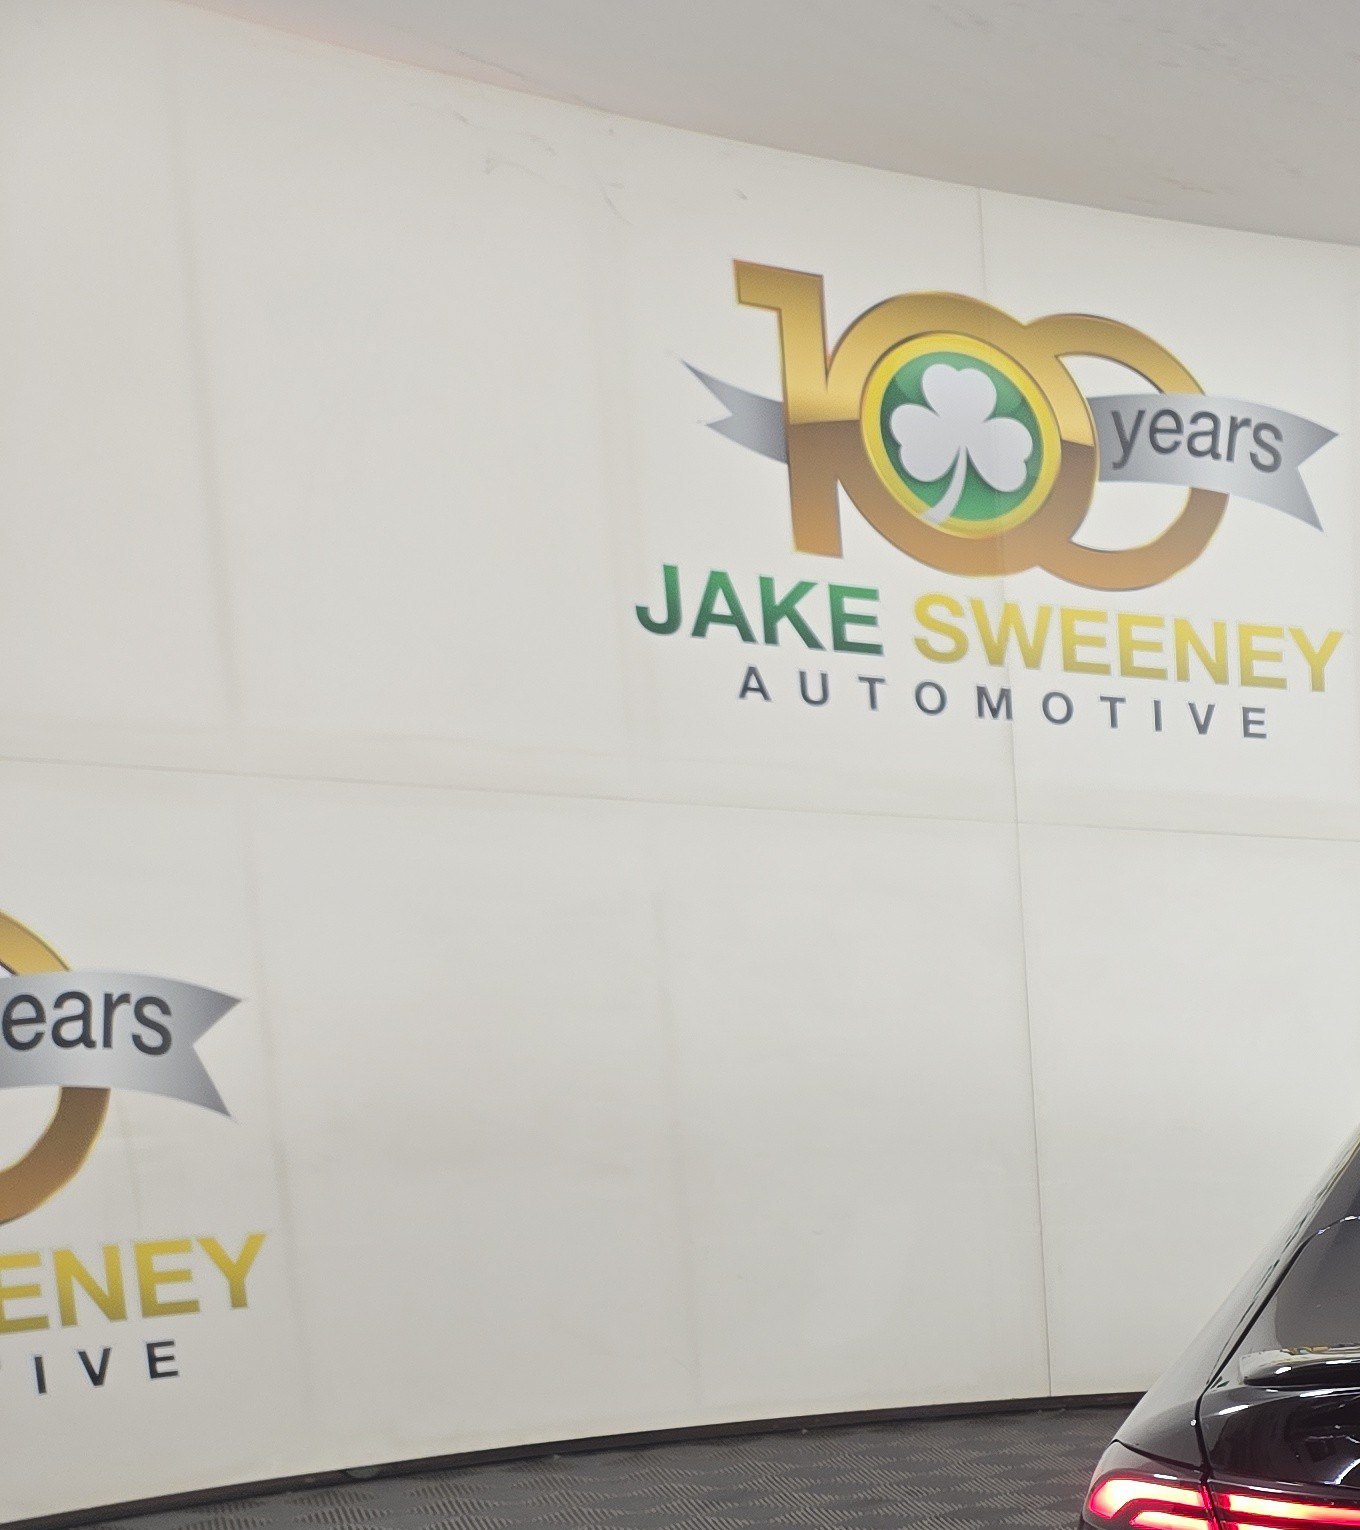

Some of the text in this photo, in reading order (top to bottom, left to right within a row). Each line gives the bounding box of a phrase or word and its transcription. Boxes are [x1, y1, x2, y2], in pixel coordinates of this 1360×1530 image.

[1109, 407, 1284, 473] years
[635, 564, 1345, 692] JAKE SWEENEY
[738, 665, 1267, 739] AUTOMOTIVE
[0, 990, 173, 1056] ears
[0, 1231, 267, 1335] ENEY
[34, 1341, 179, 1394] IVE
